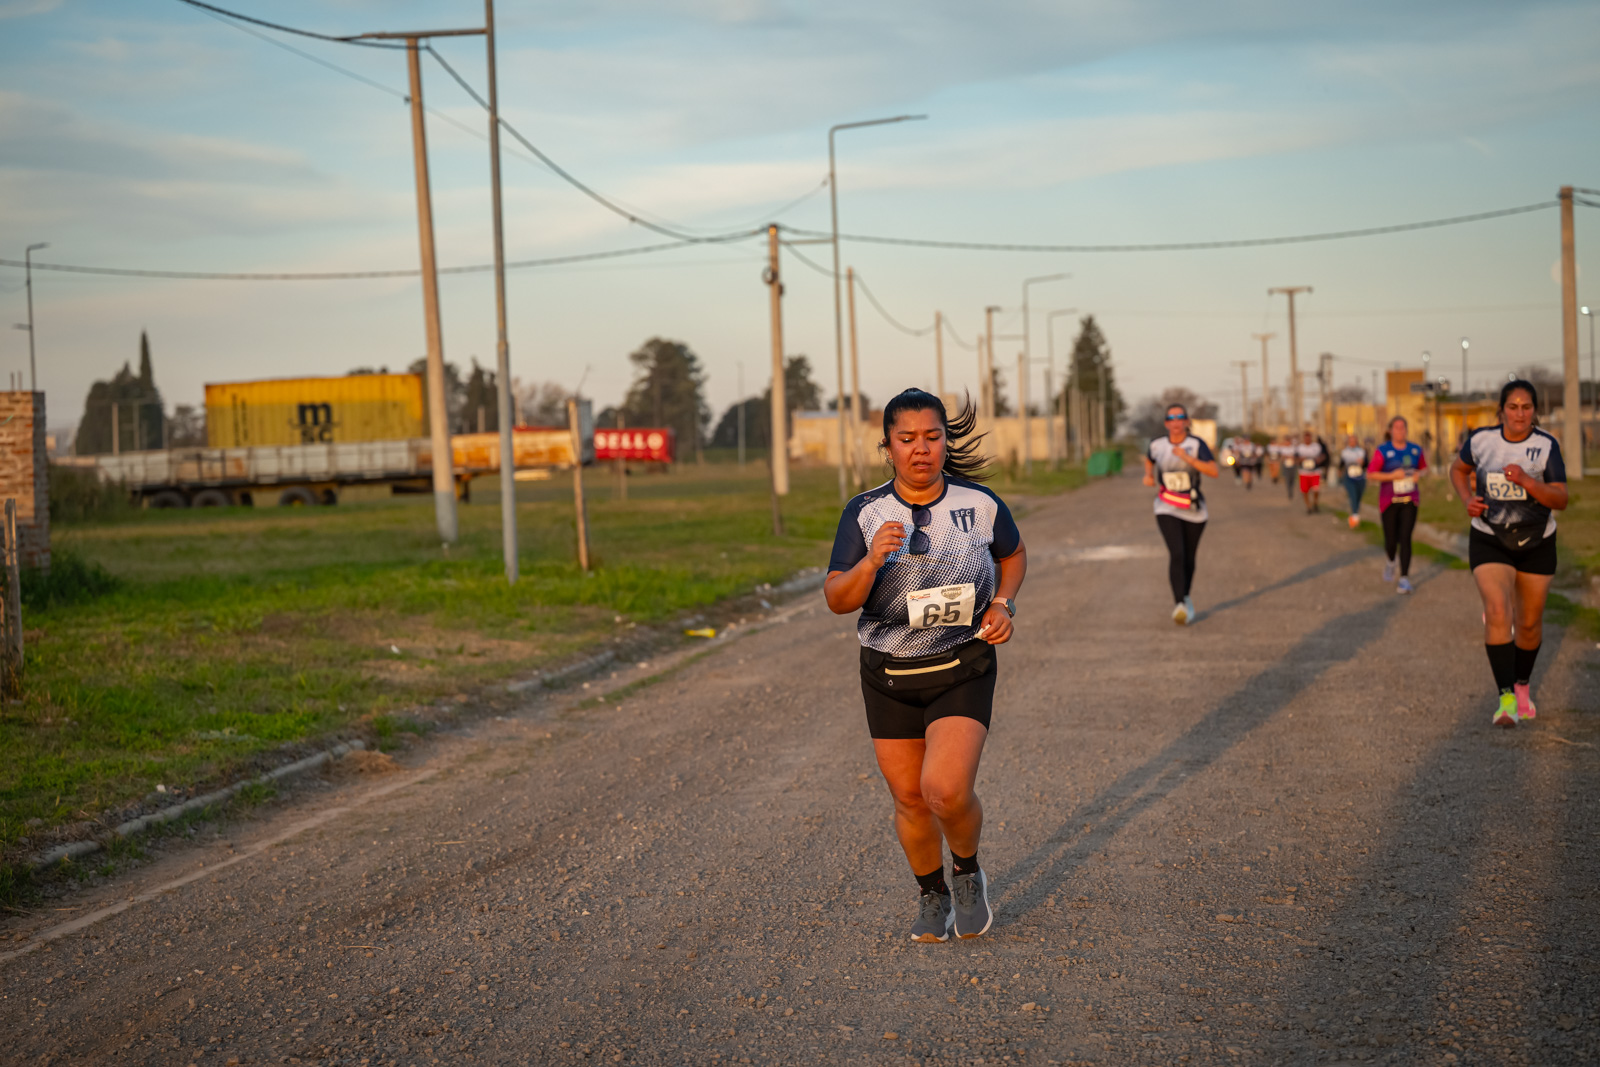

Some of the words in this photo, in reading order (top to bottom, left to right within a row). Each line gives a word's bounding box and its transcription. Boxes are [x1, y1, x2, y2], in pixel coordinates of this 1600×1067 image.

[1489, 482, 1524, 498] 525
[954, 509, 972, 517] SFC
[922, 601, 961, 628] 65
